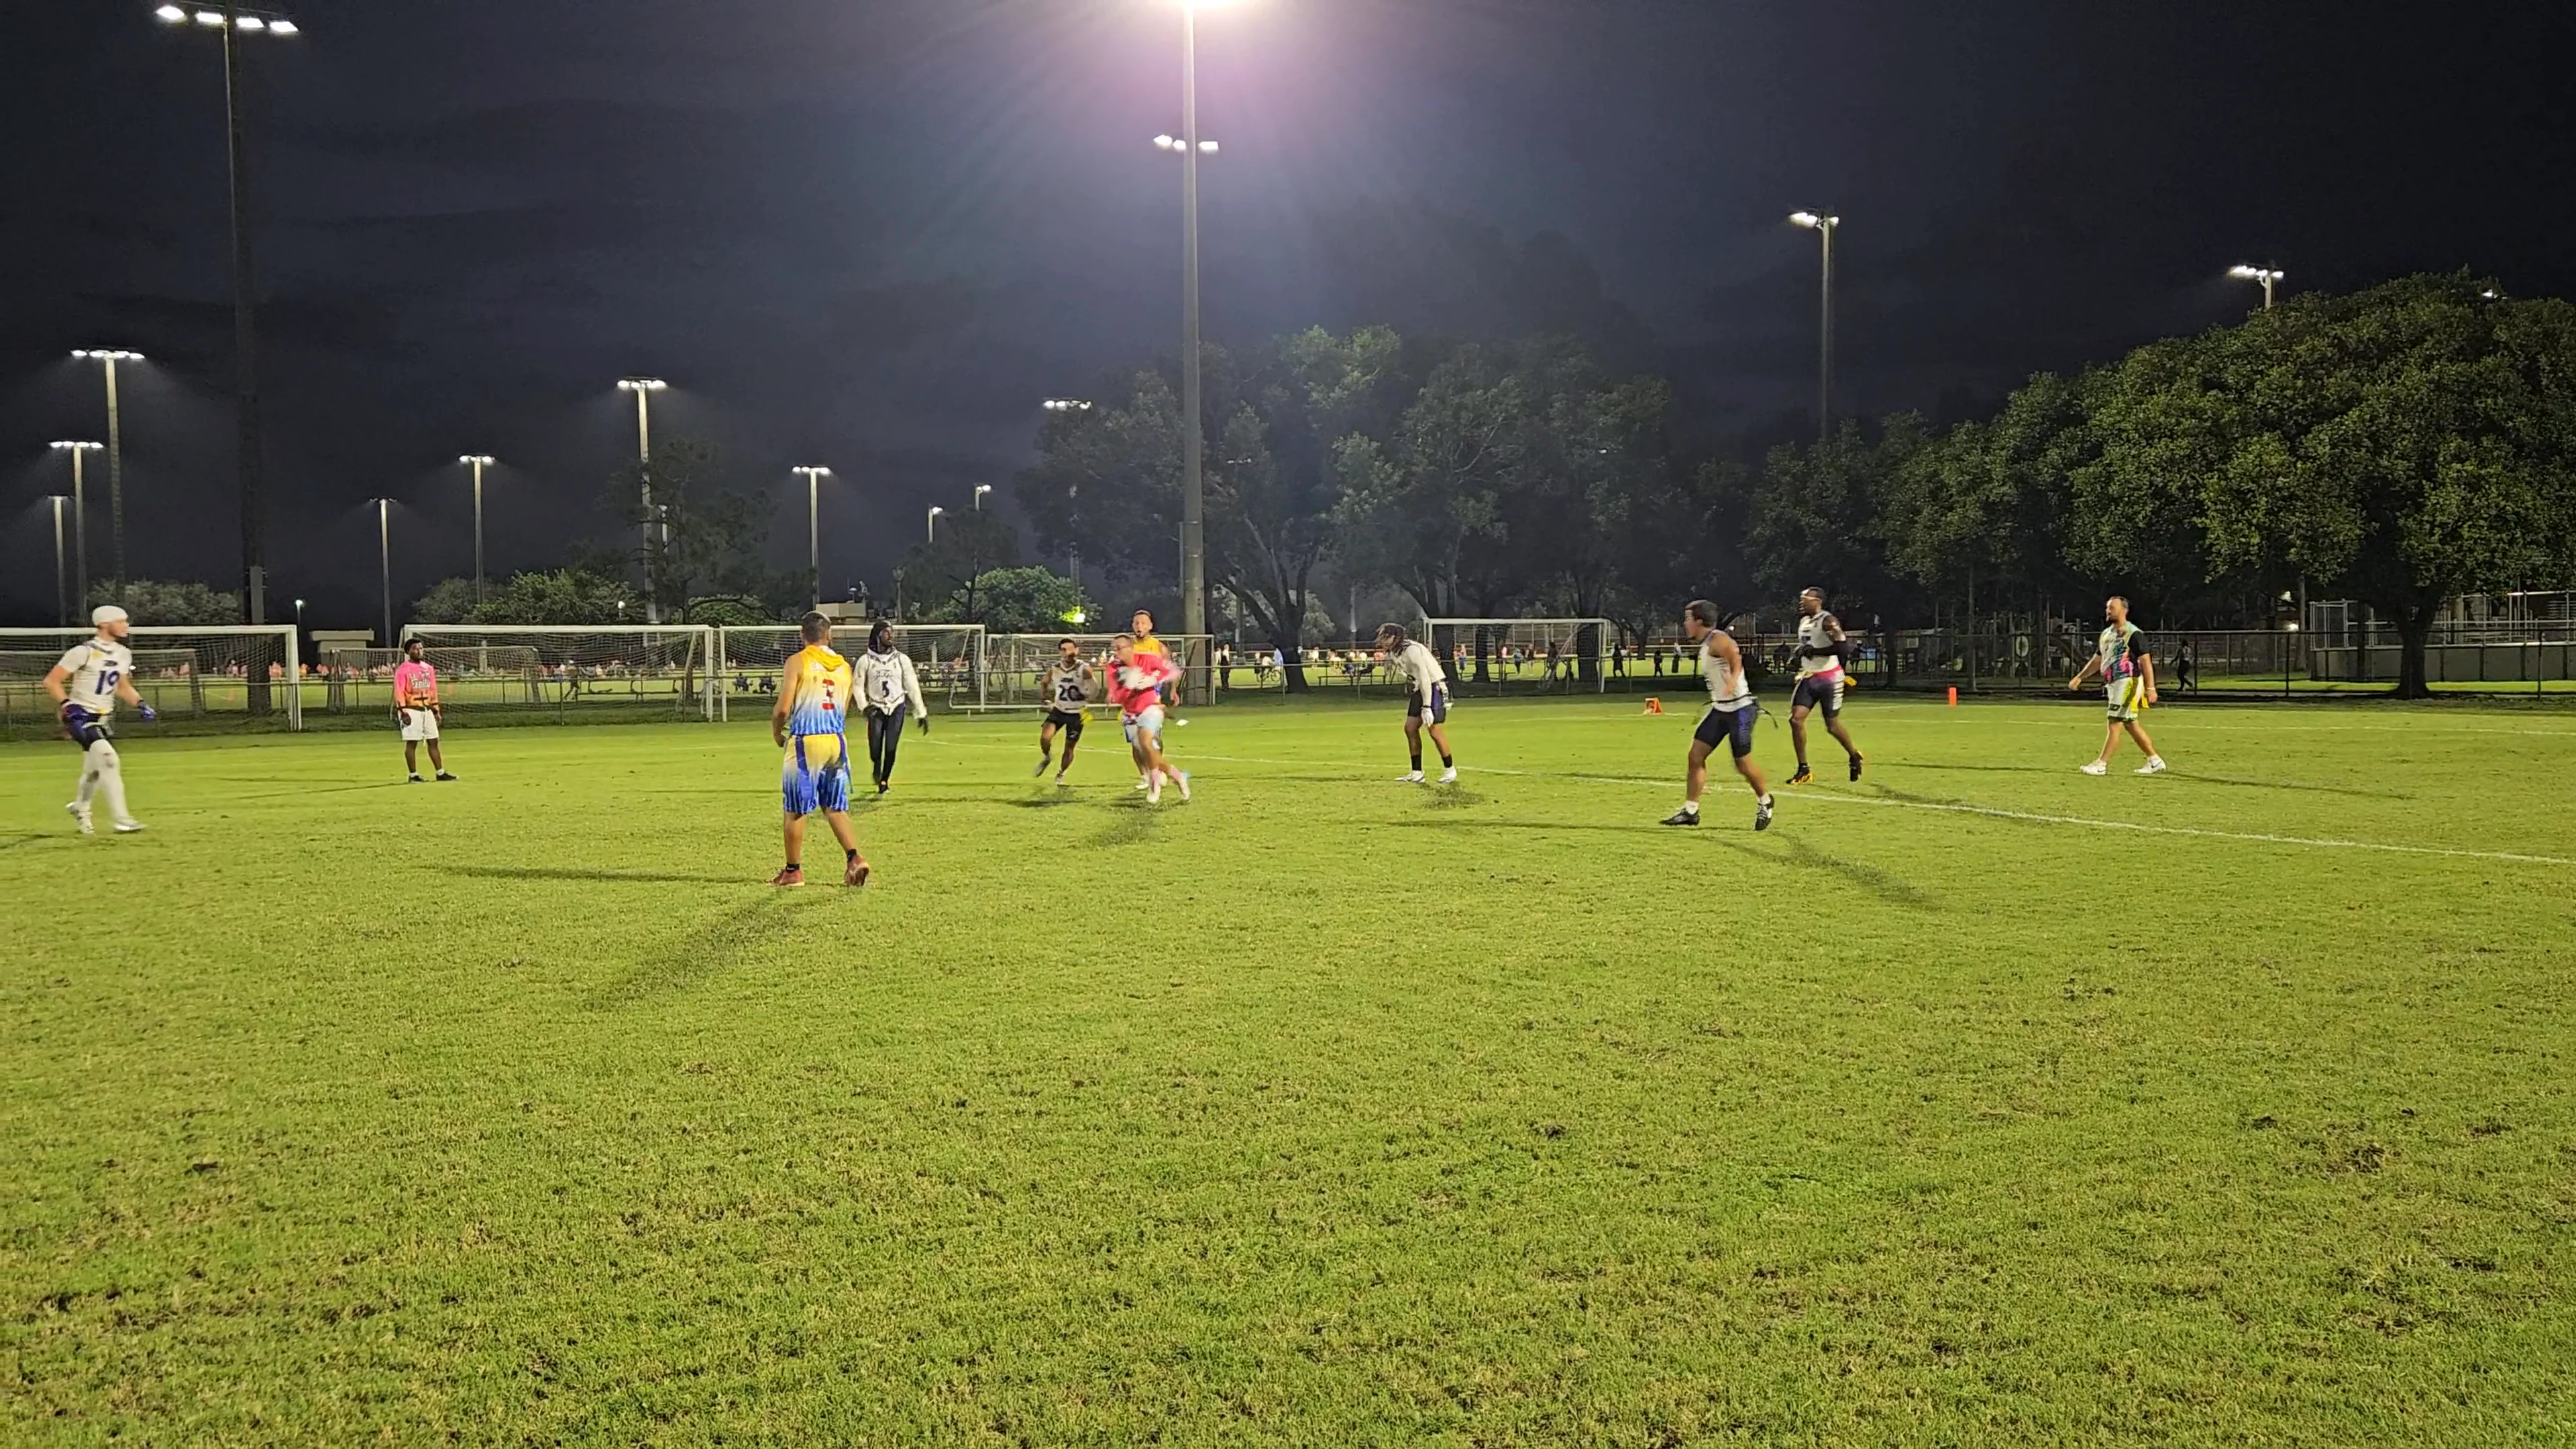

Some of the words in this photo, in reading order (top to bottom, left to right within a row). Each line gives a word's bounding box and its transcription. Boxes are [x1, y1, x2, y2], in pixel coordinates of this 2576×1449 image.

[95, 669, 120, 696] 19
[881, 680, 890, 698] 5
[1058, 684, 1085, 702] 20
